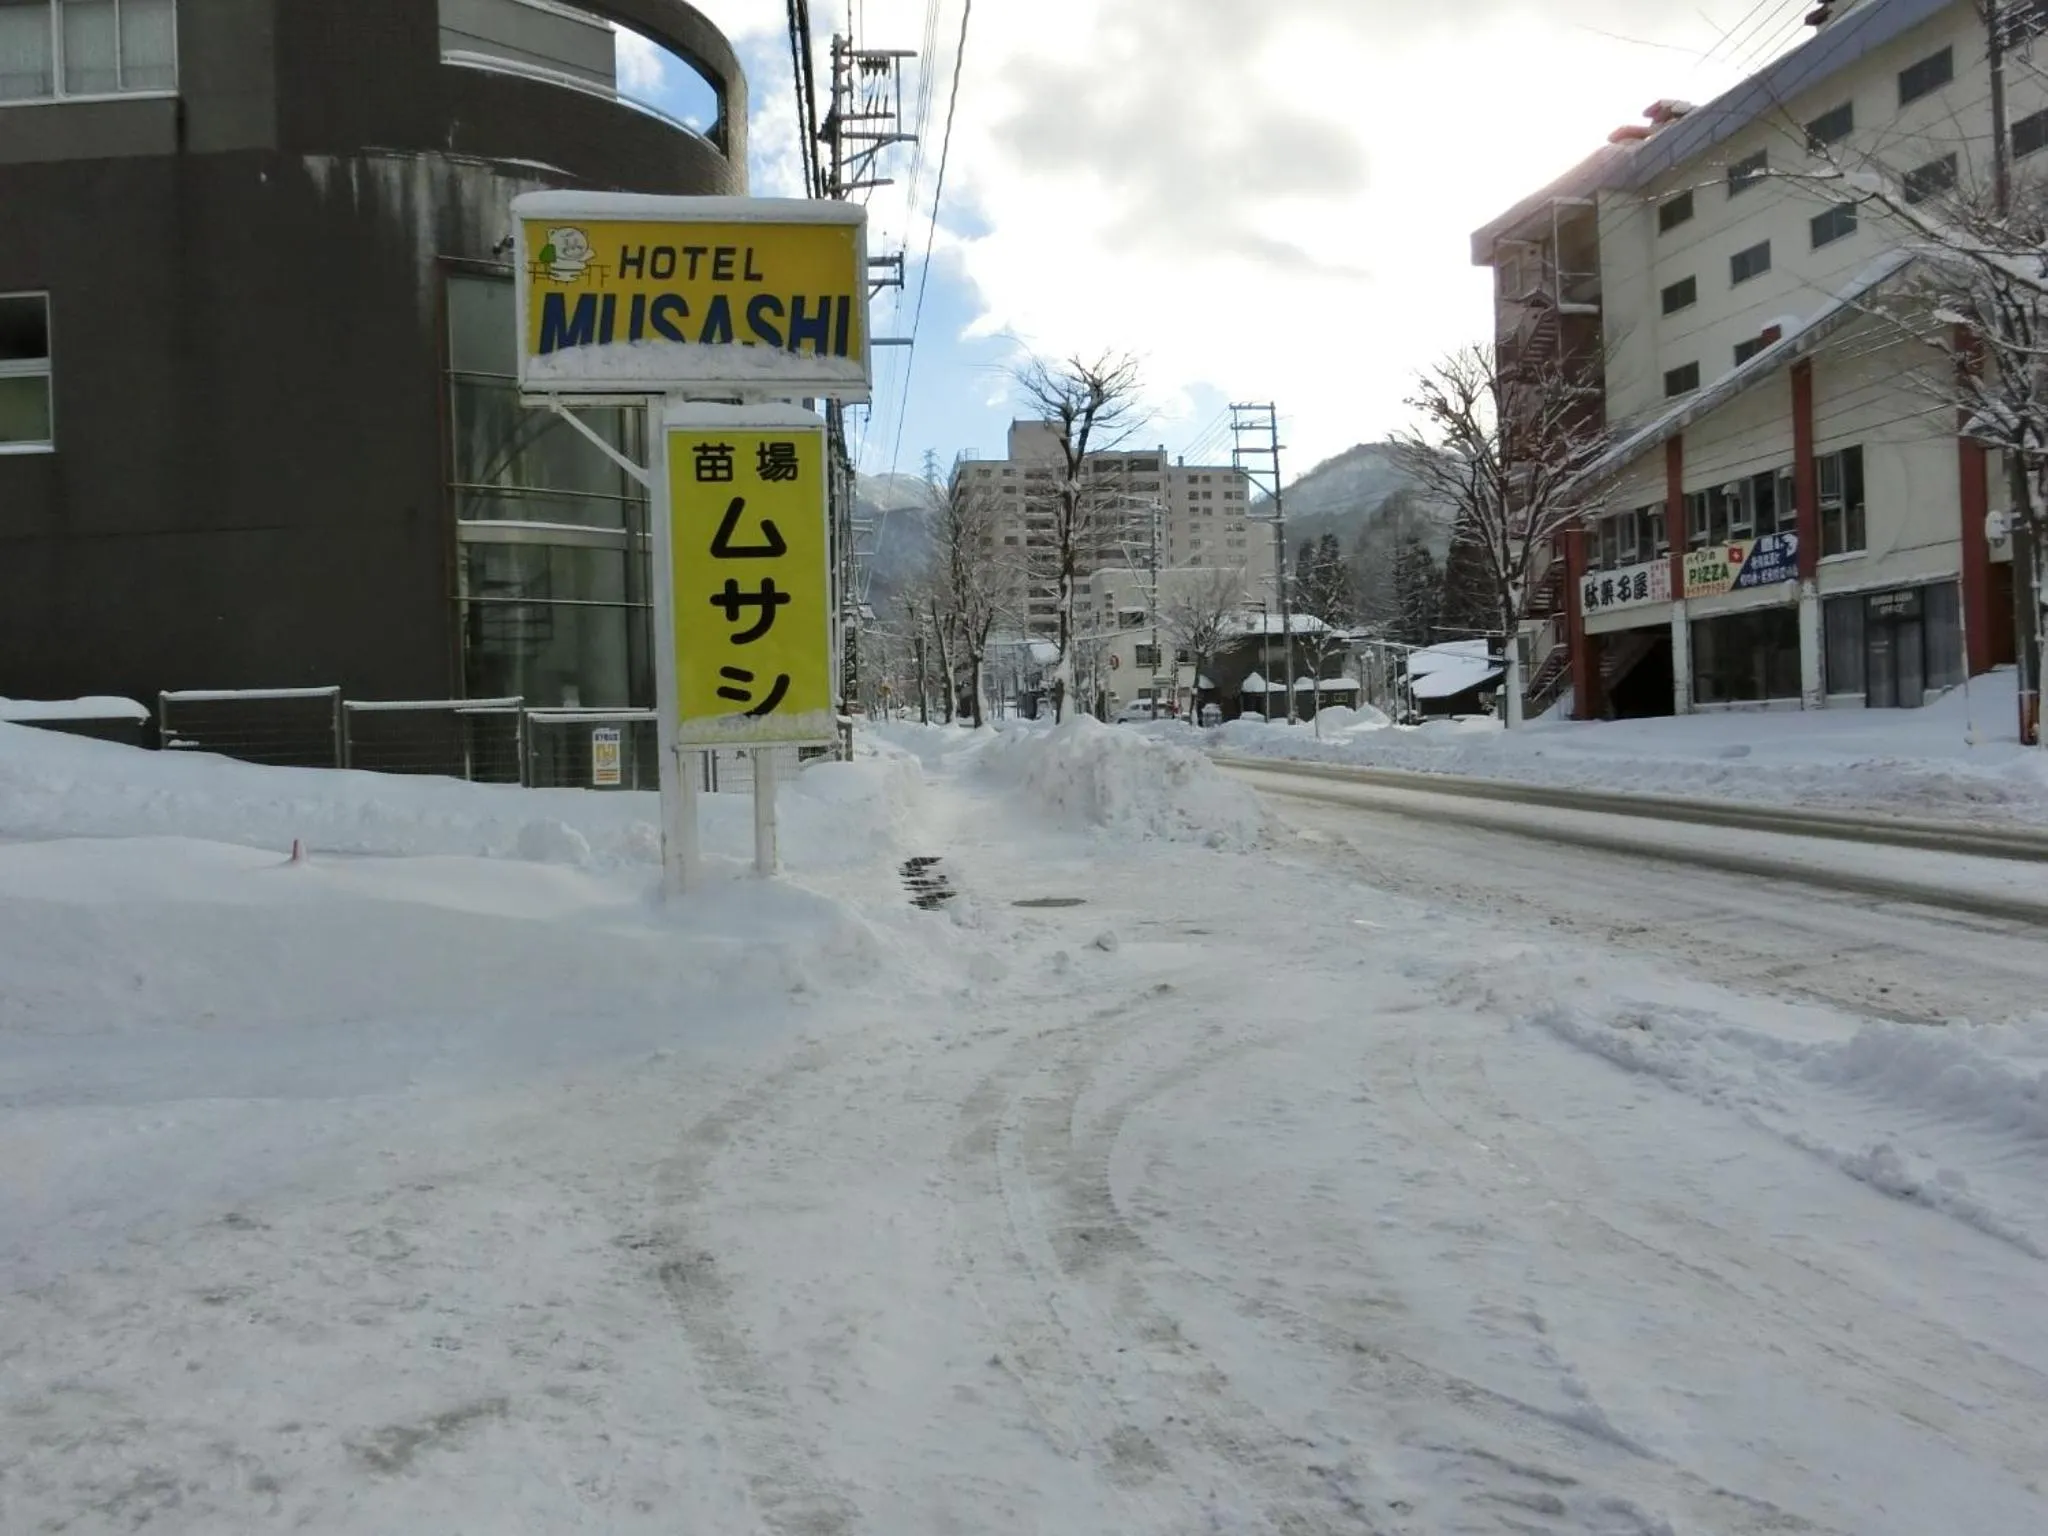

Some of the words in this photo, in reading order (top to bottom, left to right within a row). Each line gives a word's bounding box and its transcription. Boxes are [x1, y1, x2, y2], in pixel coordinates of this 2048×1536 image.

[619, 245, 763, 282] HOTEL
[692, 441, 799, 483] 苗場
[1689, 562, 1729, 585] PIZZA
[710, 496, 791, 719] ムサシ
